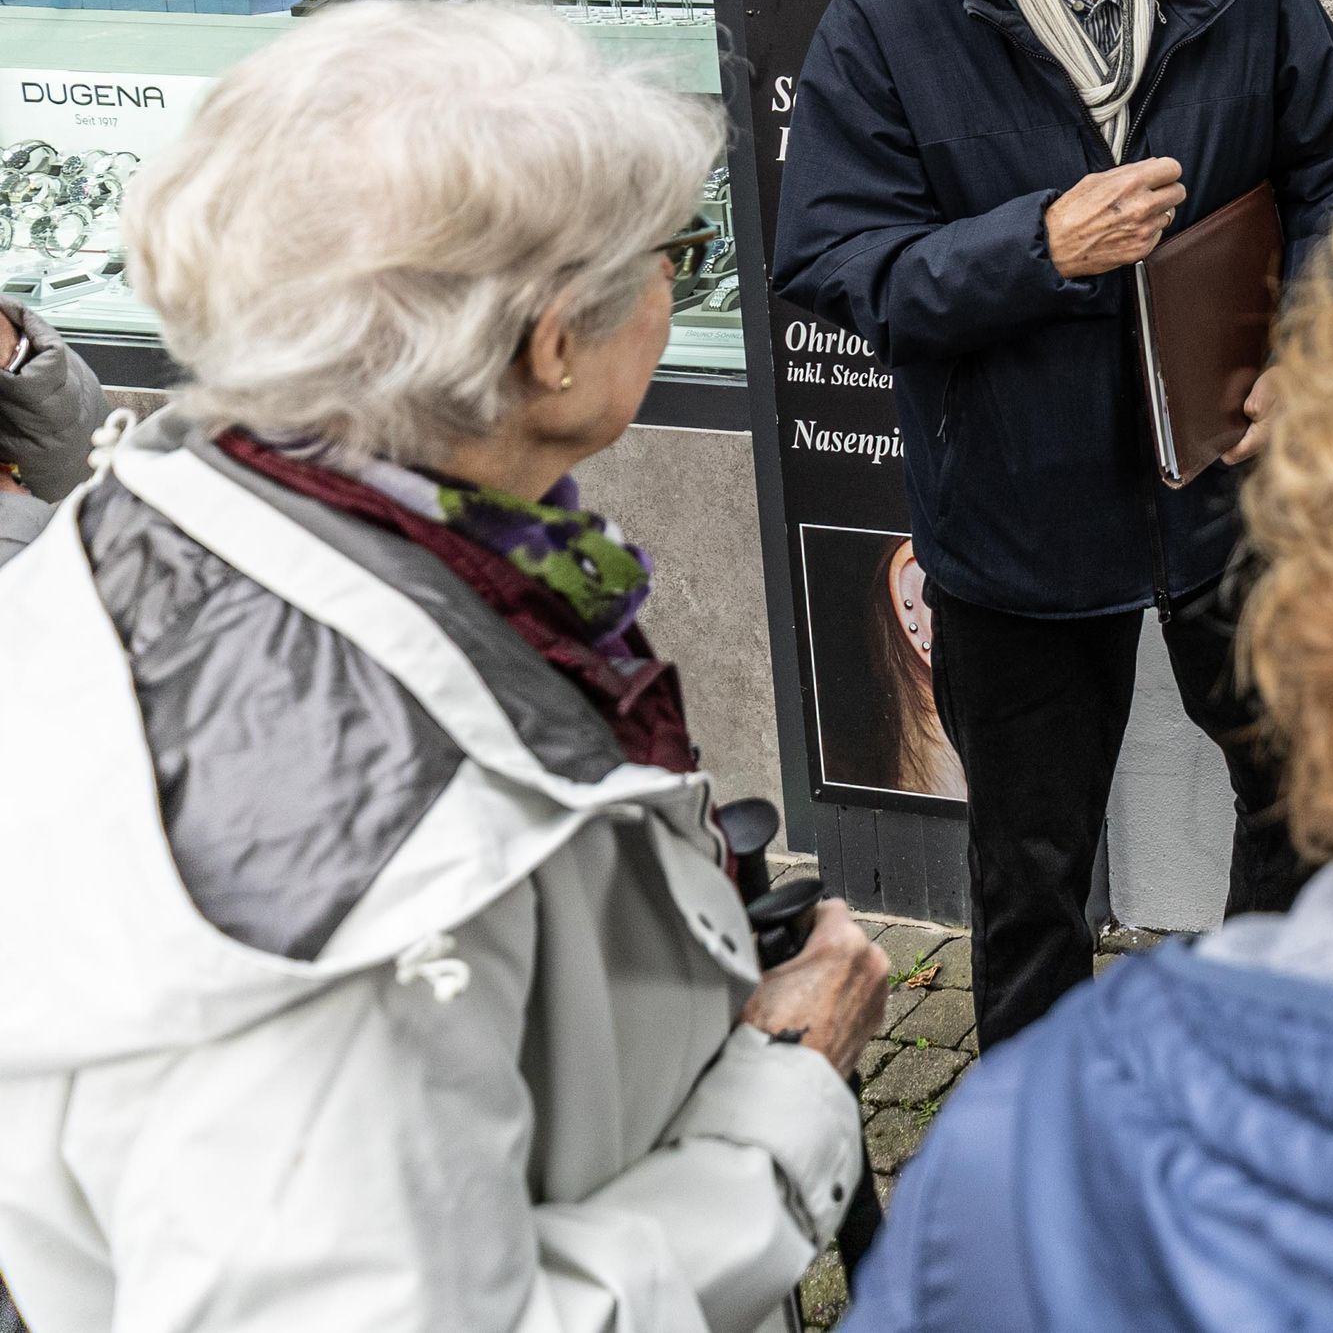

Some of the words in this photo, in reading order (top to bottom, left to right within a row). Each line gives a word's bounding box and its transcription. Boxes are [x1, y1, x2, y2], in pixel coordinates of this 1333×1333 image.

[22, 82, 165, 108] DUGENA
[75, 113, 95, 126] Seit
[99, 117, 118, 127] 1917
[786, 360, 826, 384] inkl.
[791, 419, 904, 465] Nasenpi
